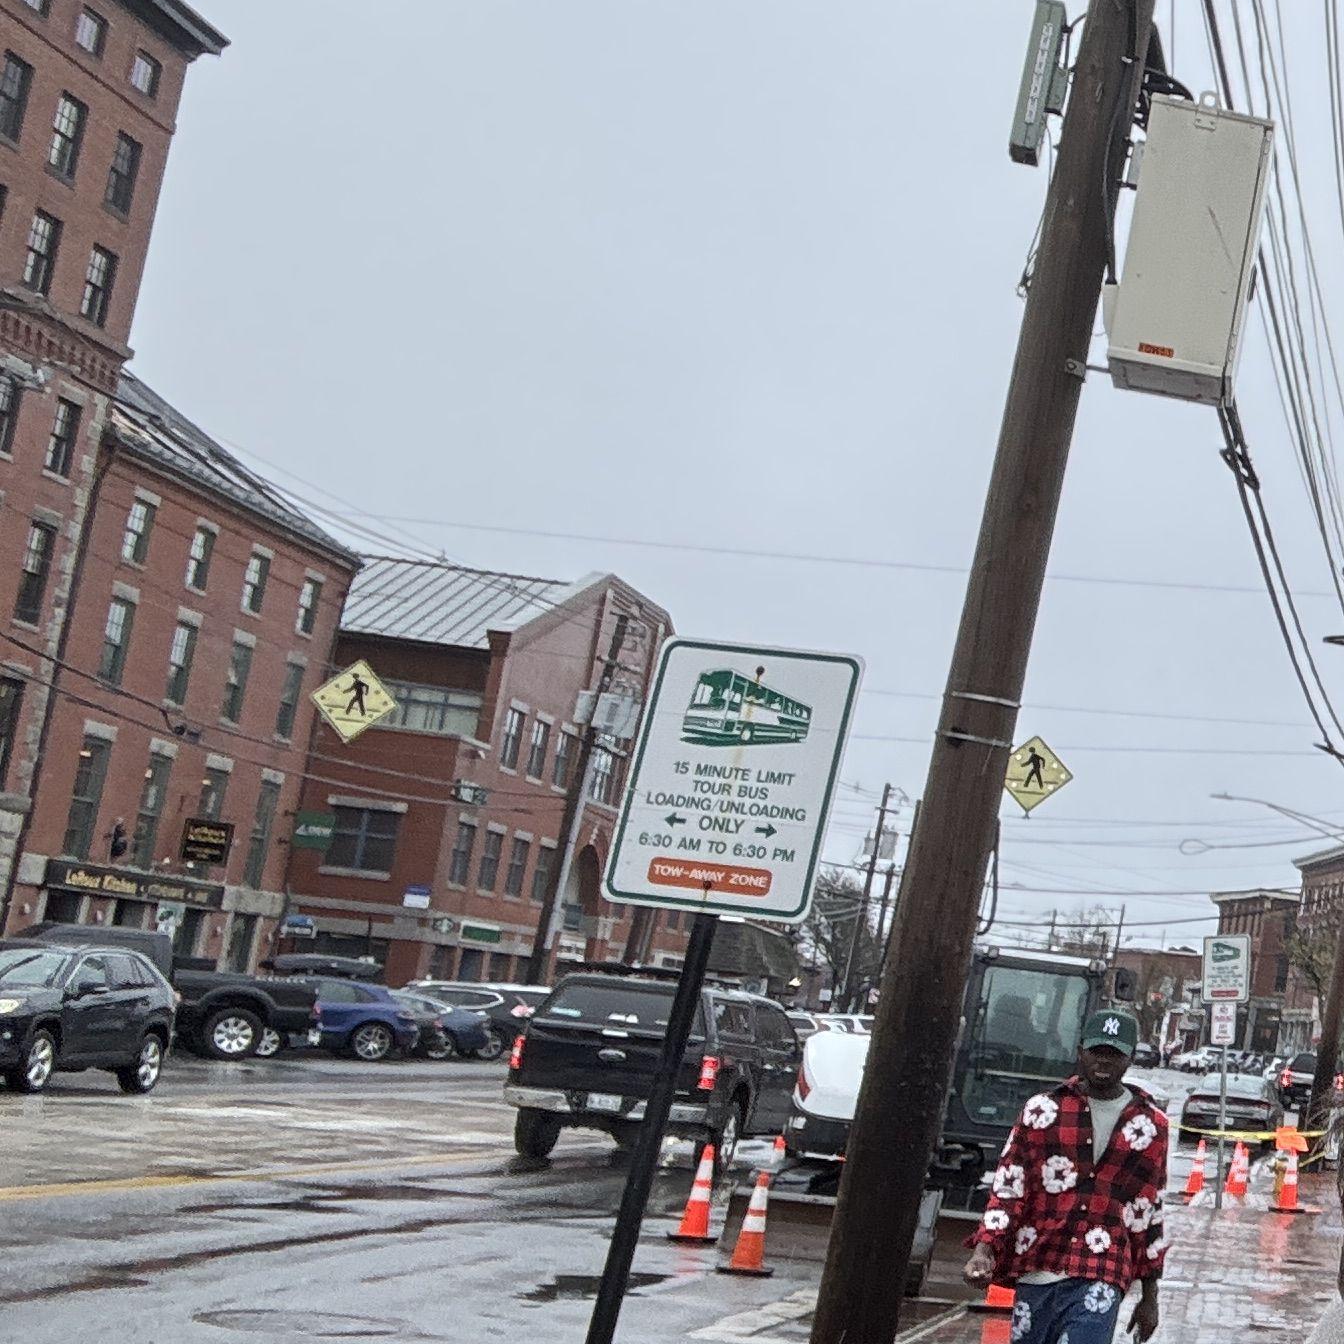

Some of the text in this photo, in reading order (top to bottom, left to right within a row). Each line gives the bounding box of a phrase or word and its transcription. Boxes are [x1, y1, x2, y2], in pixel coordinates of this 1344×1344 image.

[674, 761, 796, 786] 15 MINUTE LIMIT
[692, 780, 769, 800] TOUR BUS
[645, 791, 807, 822] LOADING/UNLOADING
[699, 815, 745, 834] ONLY
[638, 831, 796, 863] 6:30 AM TO 6:30 PM
[653, 863, 768, 888] TOW-AWAY ZONE
